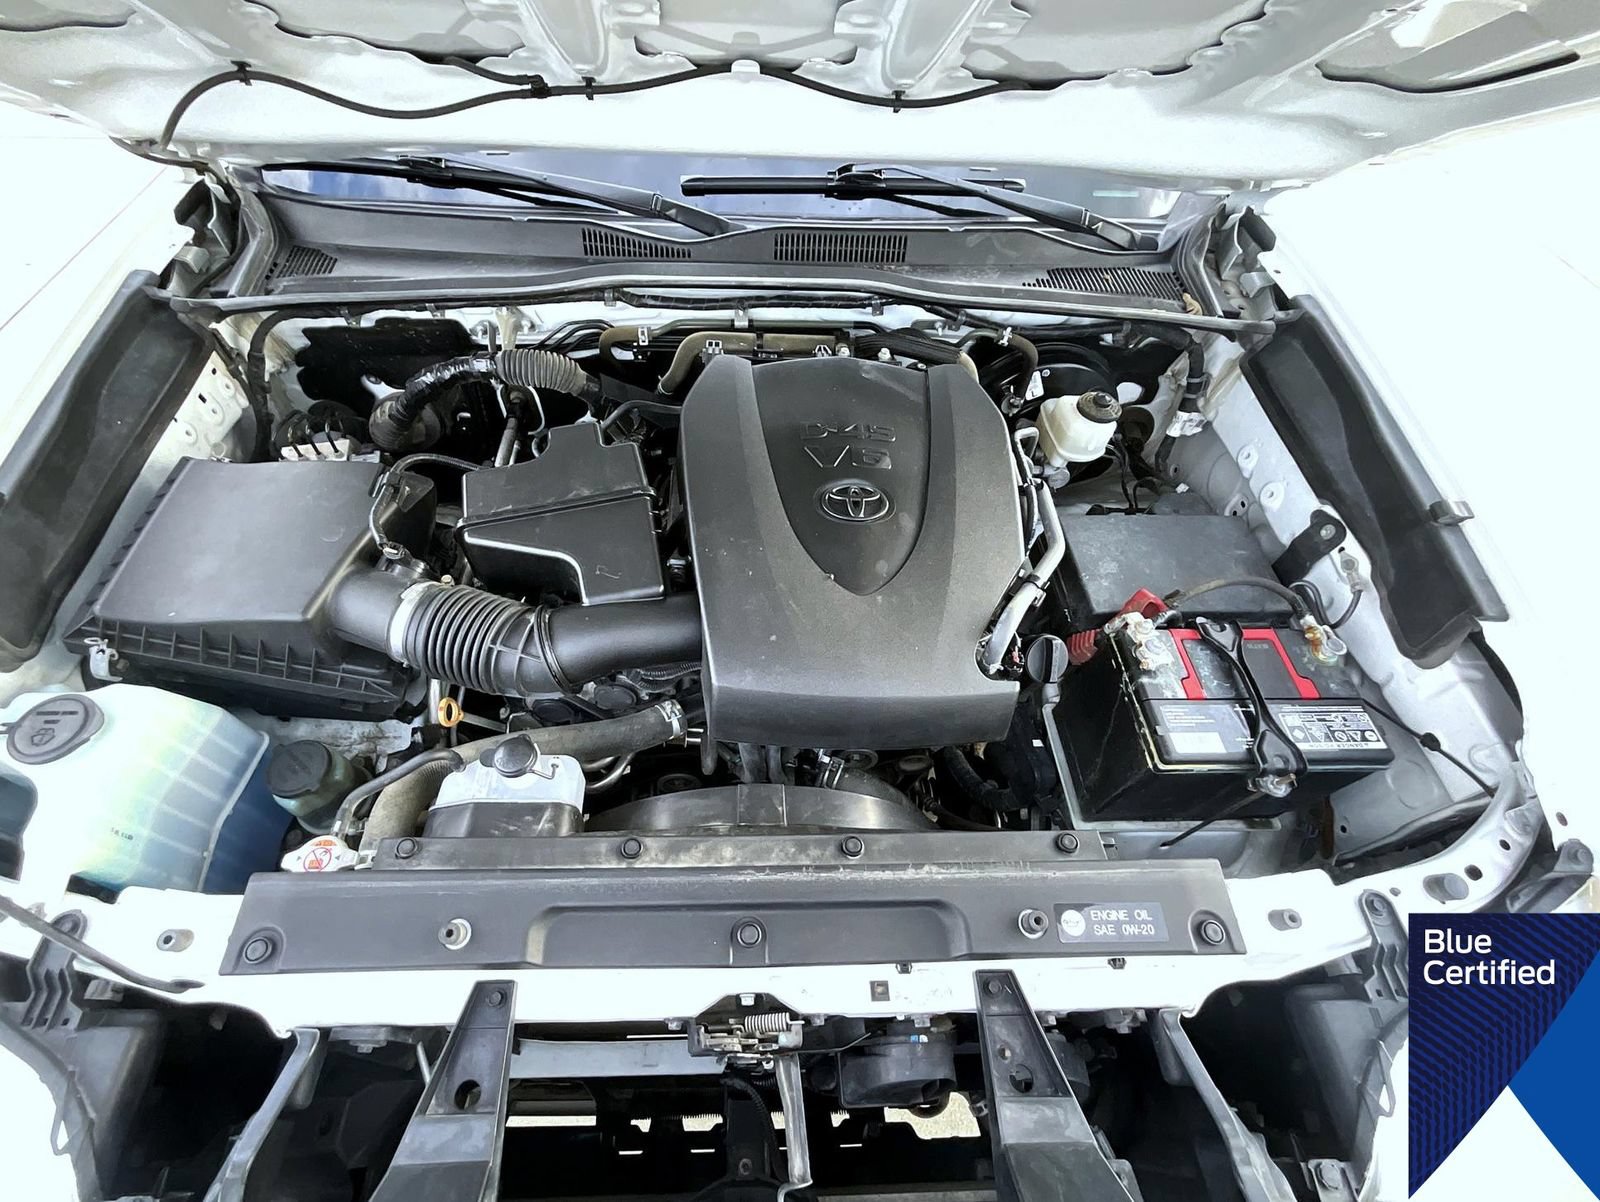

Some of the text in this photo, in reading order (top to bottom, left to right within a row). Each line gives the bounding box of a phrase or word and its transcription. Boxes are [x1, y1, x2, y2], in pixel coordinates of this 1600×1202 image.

[803, 444, 892, 470] V6
[1090, 909, 1153, 921] ENGINE OIL
[1093, 923, 1117, 936] SAE
